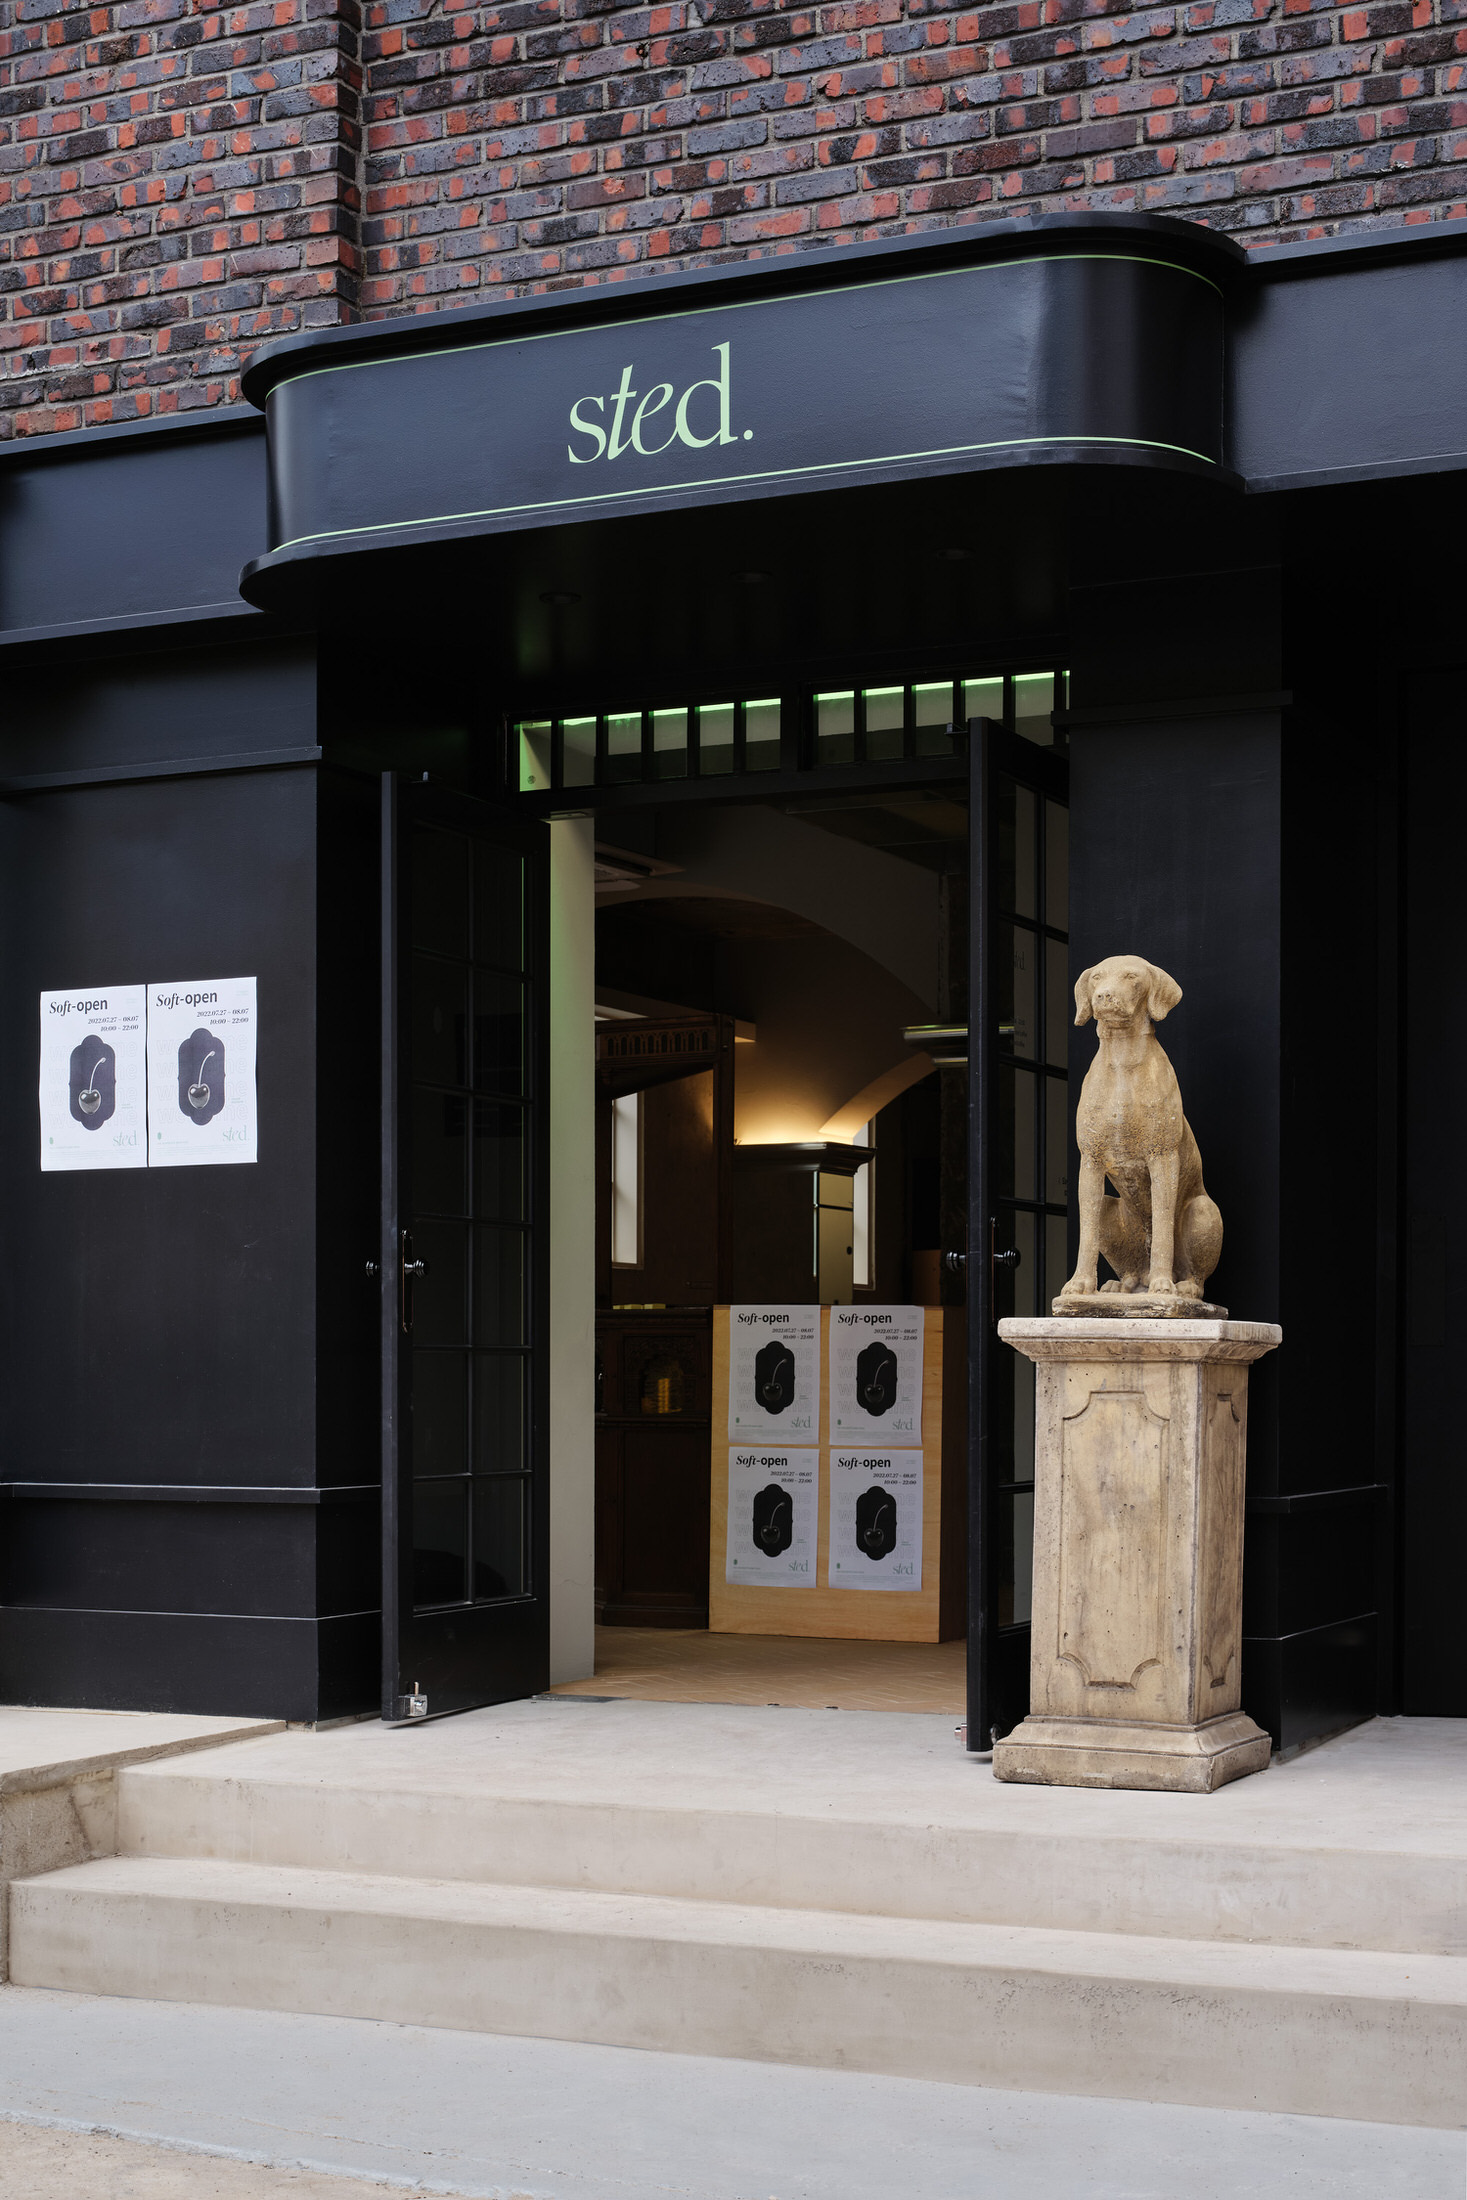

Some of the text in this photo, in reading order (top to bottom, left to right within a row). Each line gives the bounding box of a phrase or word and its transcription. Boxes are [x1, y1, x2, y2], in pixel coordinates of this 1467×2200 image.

[568, 341, 753, 463] sted.
[49, 998, 108, 1017] Soft-open
[156, 991, 218, 1010] Soft-open
[737, 1312, 790, 1326] Soft-open
[837, 1313, 892, 1327] Soft-open
[736, 1455, 788, 1468] Soft-open
[837, 1457, 891, 1470] Soft-open
